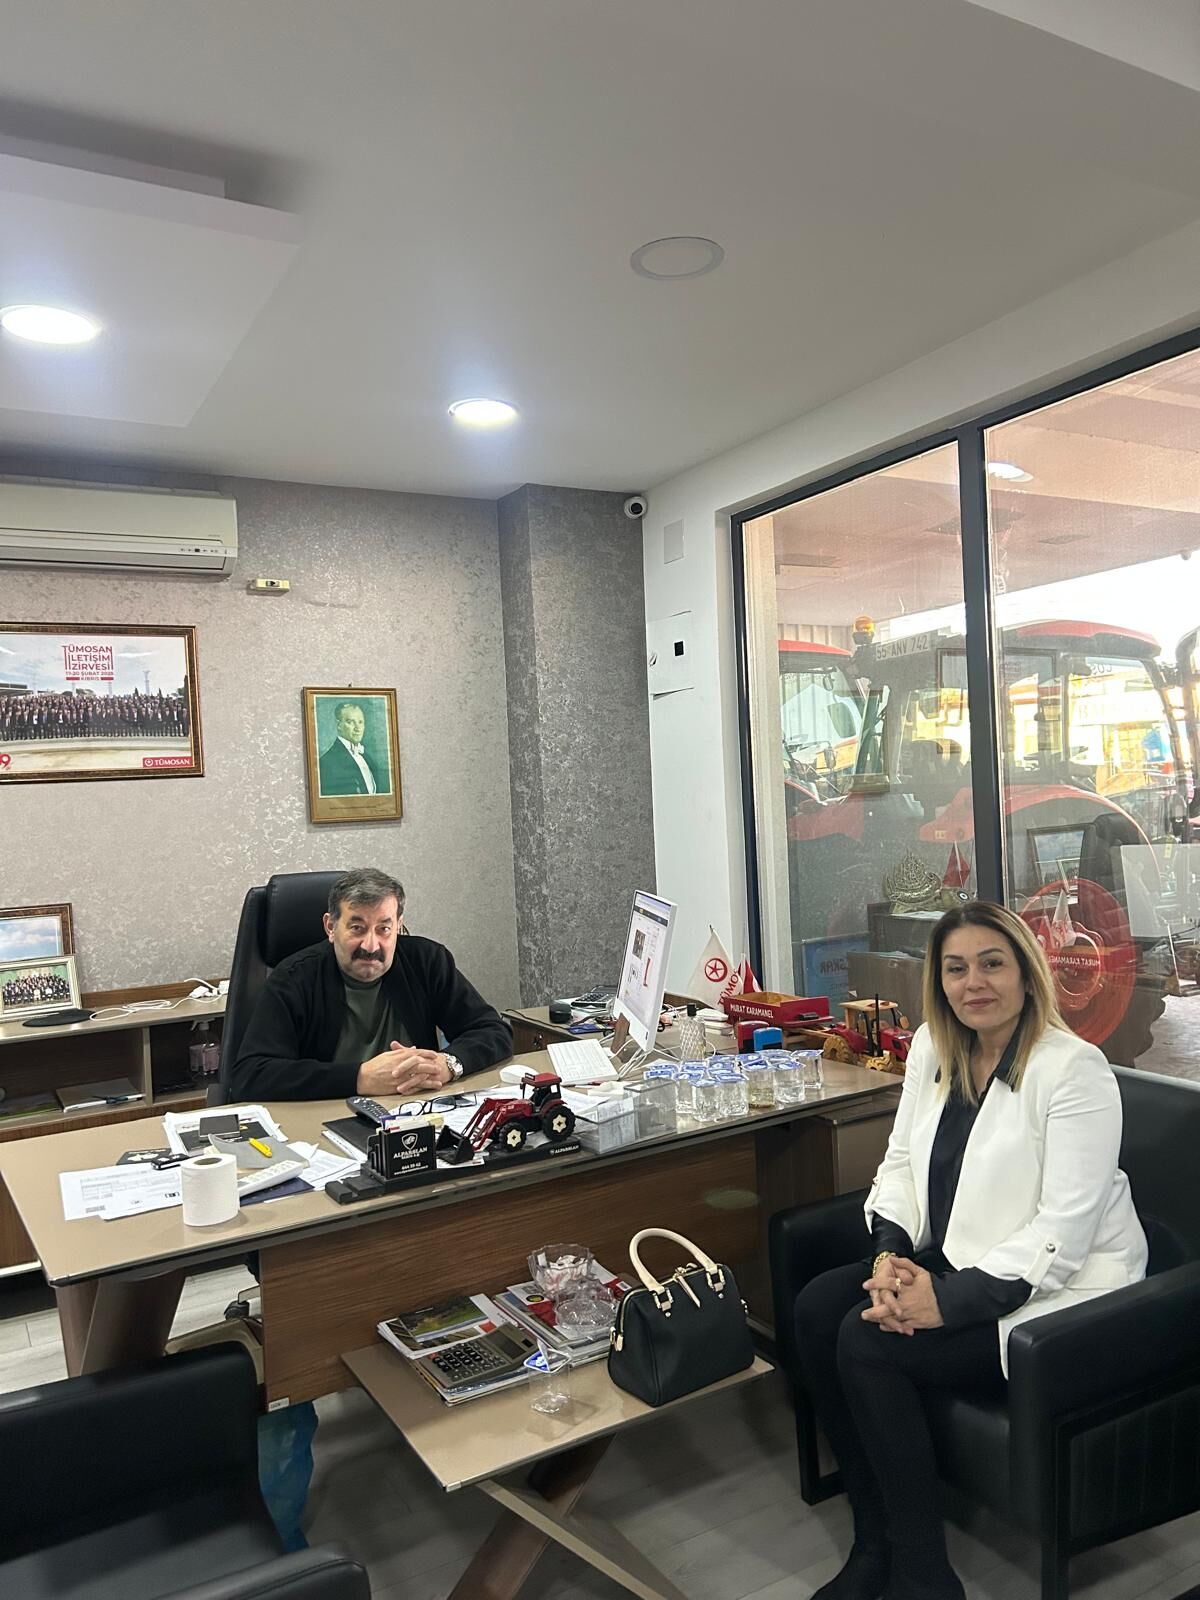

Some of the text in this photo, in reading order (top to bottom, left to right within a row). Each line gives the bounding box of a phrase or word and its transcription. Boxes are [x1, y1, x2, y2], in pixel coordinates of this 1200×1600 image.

[61, 643, 114, 653] TÜMOSAN
[876, 646, 887, 659] 55
[67, 653, 111, 663] İLETİŞİM
[71, 662, 111, 671] ZİRVESİ
[154, 758, 190, 766] TÜMOSAN
[717, 968, 739, 1006] TÜMO
[730, 1003, 774, 1019] MURAT KARAMANEL
